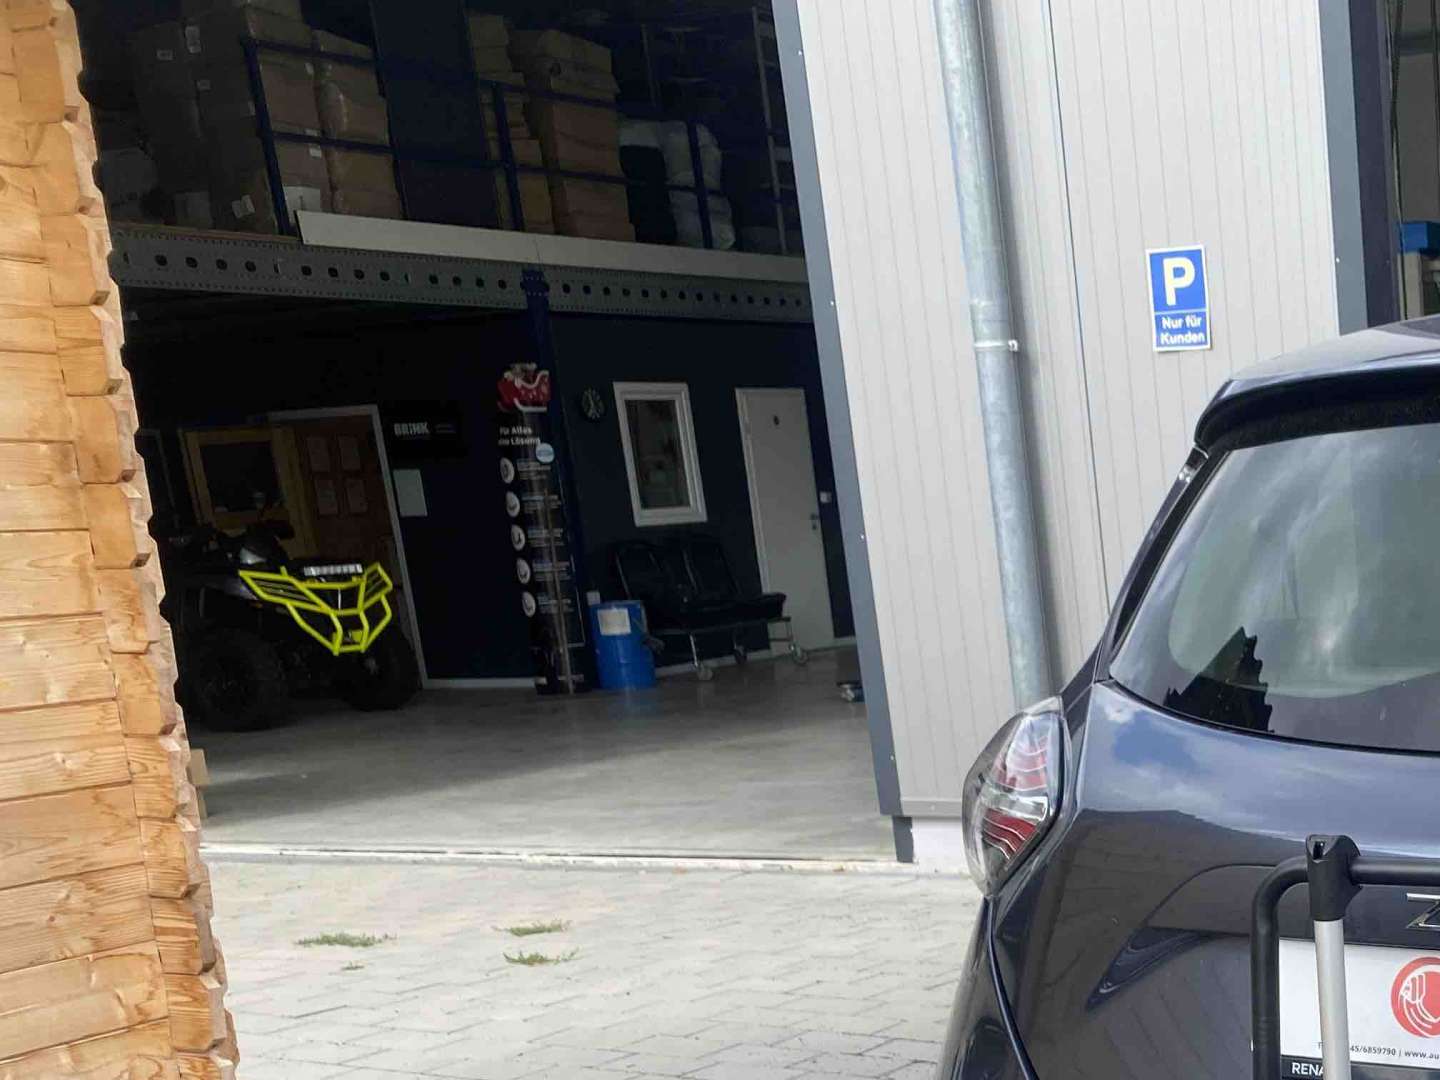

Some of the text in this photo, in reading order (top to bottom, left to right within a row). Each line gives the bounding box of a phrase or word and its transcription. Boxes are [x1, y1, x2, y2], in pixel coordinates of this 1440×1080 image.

[1163, 257, 1196, 306] P
[1161, 315, 1202, 329] Nur für
[1160, 331, 1205, 345] Kunden
[1291, 1062, 1325, 1077] RENA
